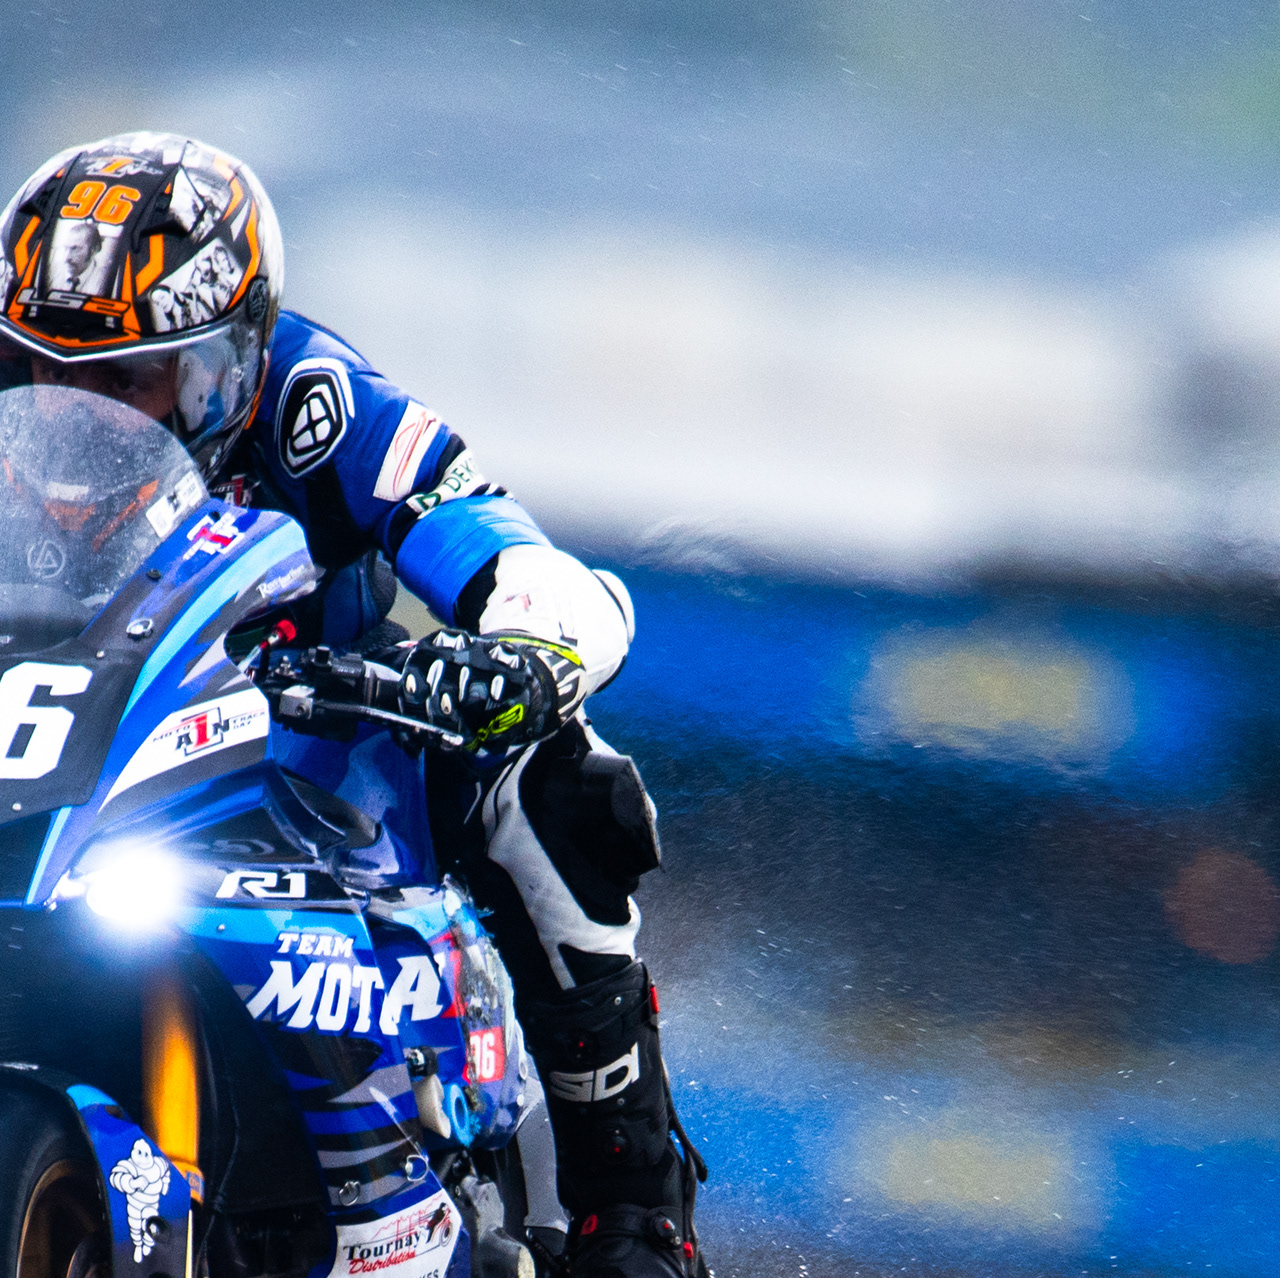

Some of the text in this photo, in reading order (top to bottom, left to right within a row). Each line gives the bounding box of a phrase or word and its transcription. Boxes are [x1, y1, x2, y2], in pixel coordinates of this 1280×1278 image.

[60, 180, 141, 225] 96
[16, 287, 131, 317] LS2
[216, 871, 306, 899] R1
[276, 932, 355, 958] TEAM
[343, 1231, 421, 1260] Tournay
[348, 1251, 417, 1275] Distribution
